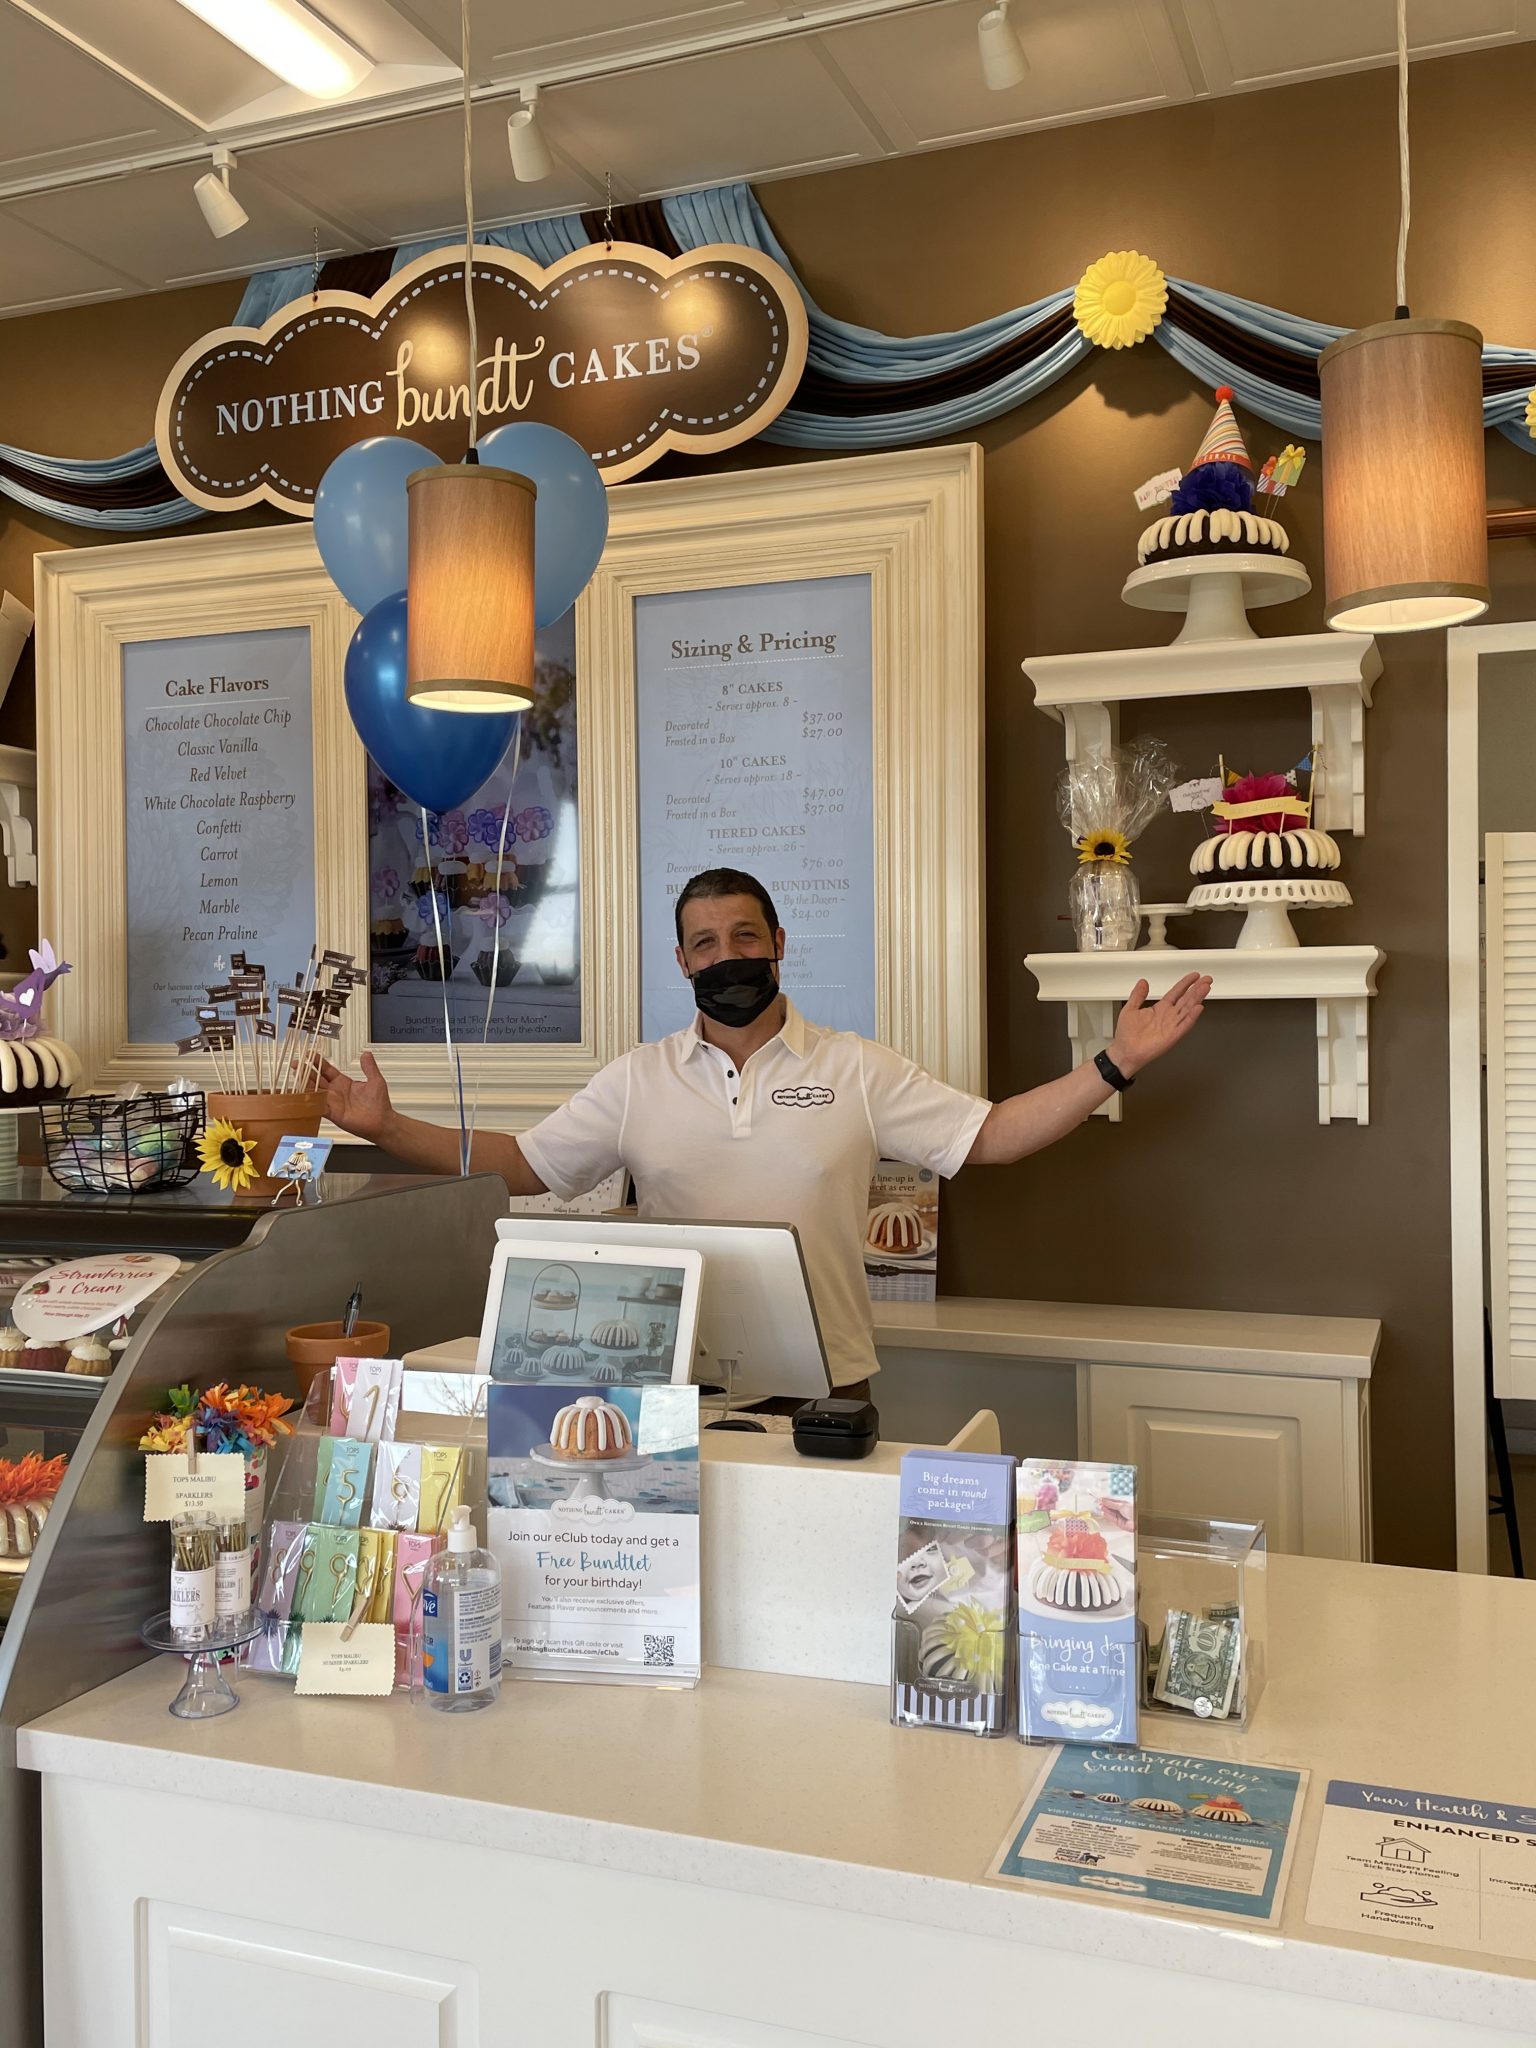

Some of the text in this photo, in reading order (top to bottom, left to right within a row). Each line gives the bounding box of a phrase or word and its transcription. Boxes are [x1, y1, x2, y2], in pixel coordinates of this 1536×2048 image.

[216, 380, 385, 435] NOTHING
[386, 336, 545, 429] bundt
[671, 630, 836, 662] Sizing & Pricing
[165, 676, 269, 697] Cake Flavors
[739, 682, 783, 695] CAKES
[716, 701, 743, 711] Serves
[145, 708, 291, 733] Chocolate Chocolate Chip
[665, 719, 710, 731] Decorated
[802, 712, 843, 724] $37.00
[665, 736, 696, 747] Frosted
[699, 737, 708, 745] in
[719, 733, 735, 743] Box
[802, 728, 843, 740] $27.00
[178, 738, 258, 757] Classic Vanilla
[742, 755, 786, 768] CAKES
[190, 767, 247, 782] Red Velvet
[714, 775, 741, 785] Serves
[144, 791, 296, 810] White Chocolate Raspberry
[666, 794, 710, 805] Decorated
[803, 788, 844, 800] $47.00
[666, 809, 697, 820] Frosted
[720, 808, 736, 818] Box
[803, 803, 844, 816] $37.00
[196, 821, 241, 839] Confetti
[707, 826, 806, 839] TIERED CAKES
[201, 847, 238, 861] Carrot
[666, 862, 712, 874] Decorated
[802, 858, 843, 869] $76.00
[201, 874, 238, 888] Lemon
[771, 879, 850, 892] BUNDTINIS
[199, 900, 240, 914] Marble
[183, 925, 258, 942] Pecan Praline
[49, 1268, 158, 1280] Strawberries
[72, 1282, 127, 1295] Cream
[434, 1451, 447, 1459] TOPS
[923, 1472, 979, 1486] Big dreams
[918, 1487, 987, 1499] come in round
[928, 1498, 975, 1512] packages!
[508, 1531, 679, 1548] Join our eClub today and get a
[536, 1551, 652, 1572] Free Bundtlet
[545, 1575, 642, 1591] for your birthday!
[522, 1637, 534, 1645] sign
[1030, 1630, 1094, 1663] Bringing
[1053, 1662, 1078, 1672] Cake
[1080, 1665, 1090, 1673] at
[1100, 1666, 1126, 1676] Time
[1091, 1750, 1269, 1784] Celebrate our
[1083, 1760, 1268, 1794] Grand Opening
[1361, 1790, 1409, 1807] Your
[1416, 1797, 1489, 1820] Health
[1496, 1810, 1508, 1822] &
[1393, 1819, 1520, 1844] ENHANCED
[1346, 1855, 1460, 1877] Team Members Feeling
[1410, 1870, 1440, 1878] Home
[1361, 1913, 1434, 1929] Handwashing
[1374, 1910, 1422, 1922] Frequent
